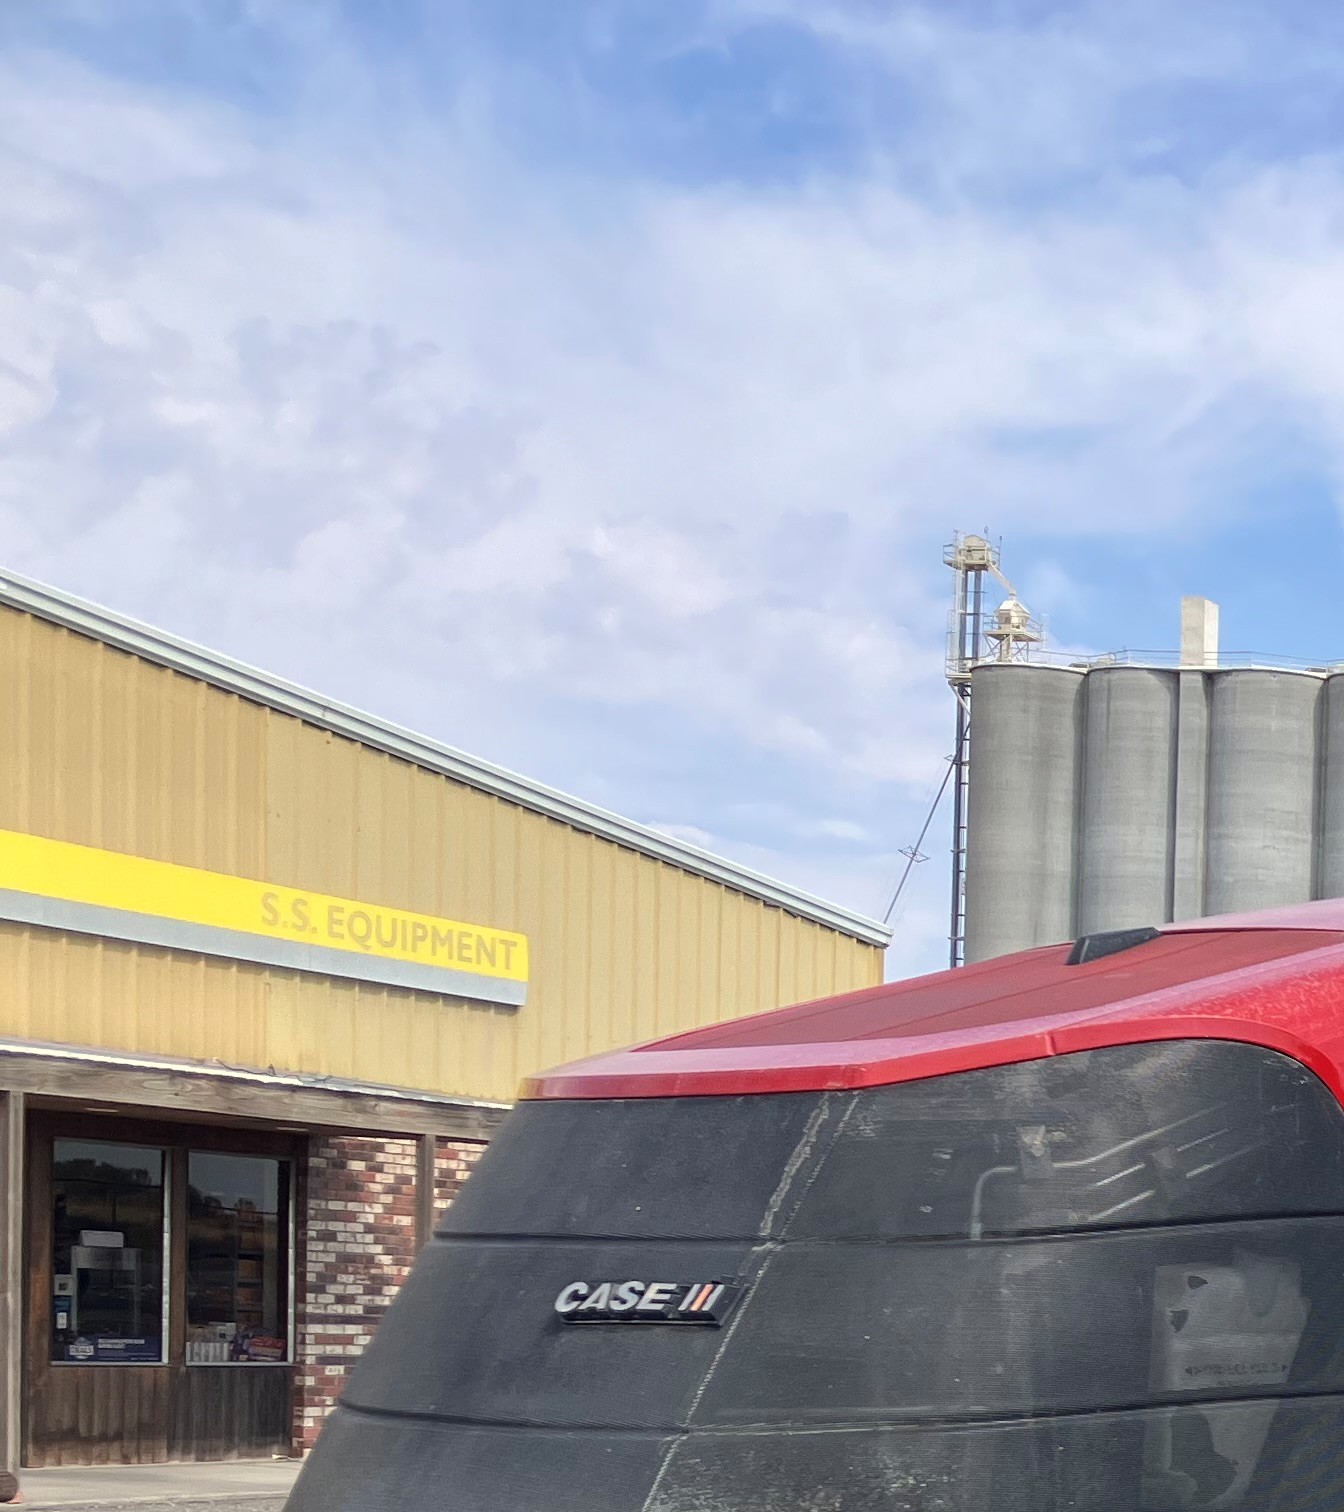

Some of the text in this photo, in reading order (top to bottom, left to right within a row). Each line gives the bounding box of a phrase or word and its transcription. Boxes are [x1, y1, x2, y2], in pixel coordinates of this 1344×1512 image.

[261, 891, 517, 971] S.S. EQUIPMENT
[554, 1280, 678, 1313] CASE
